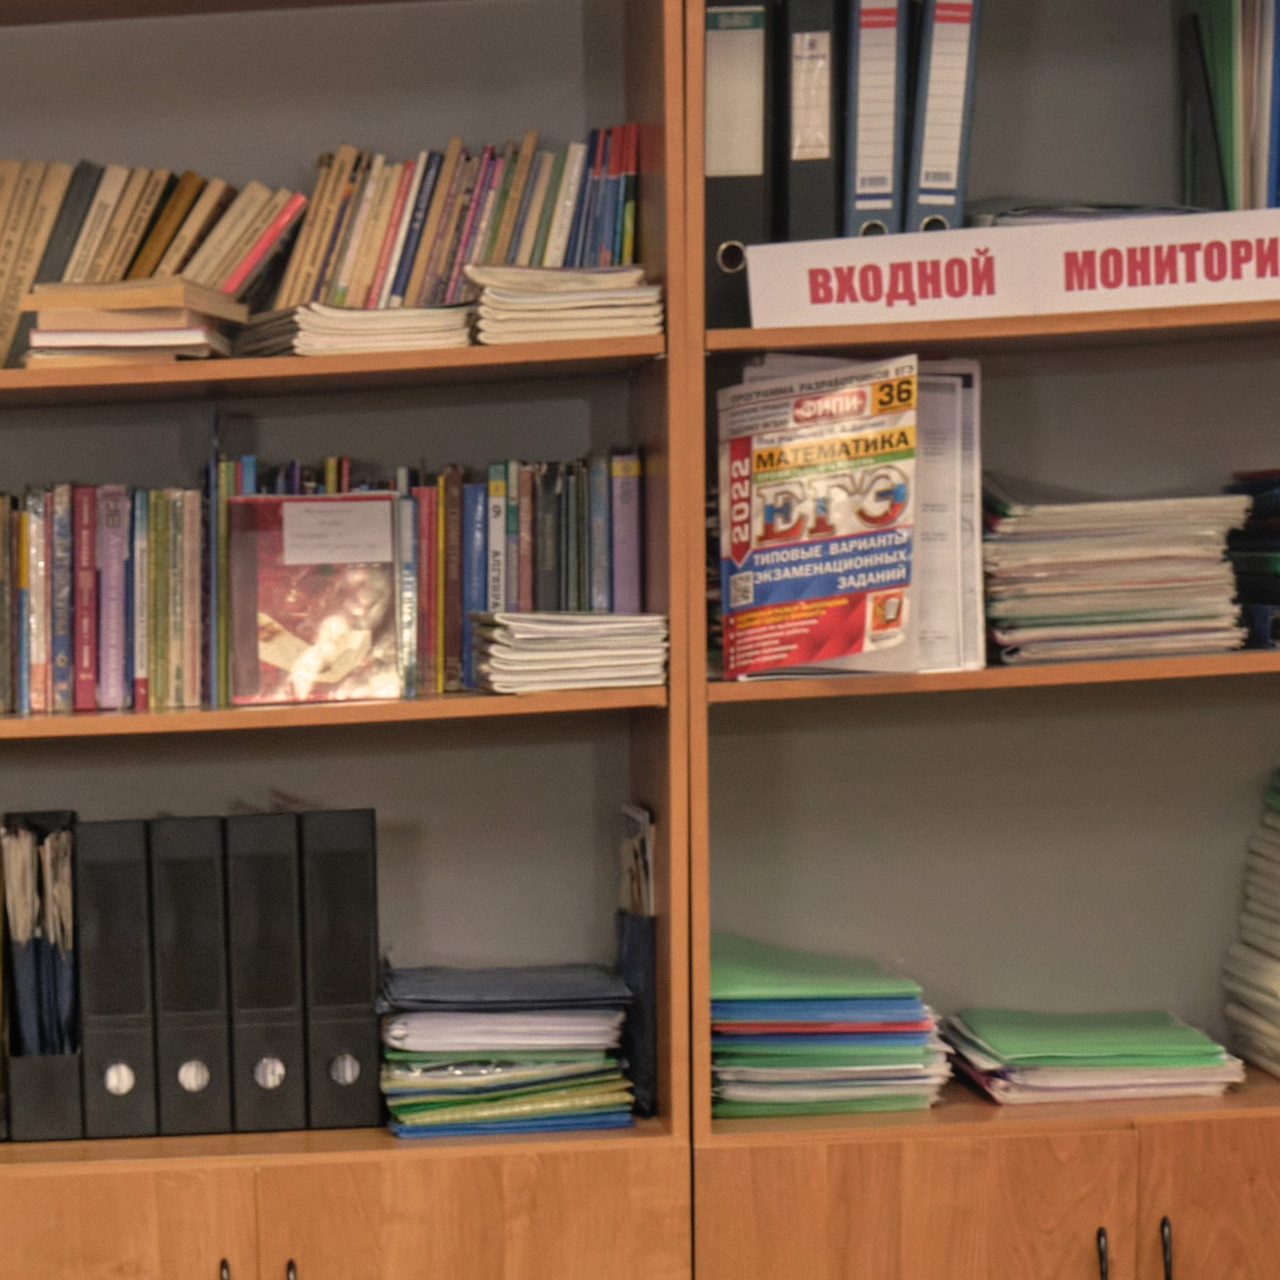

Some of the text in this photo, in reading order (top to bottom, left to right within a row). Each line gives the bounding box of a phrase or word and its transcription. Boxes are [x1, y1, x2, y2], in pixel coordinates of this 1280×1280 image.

[807, 236, 1280, 307] ВХОДНОЙ МОНИТОРИ
[878, 380, 912, 407] 36
[755, 430, 910, 470] МАТЕМАТИКА
[731, 457, 750, 544] 2022
[755, 464, 910, 543] ЕГЭ
[753, 530, 909, 567] ТИПОВЫЕ ВАРИАНТЫ
[753, 550, 908, 585] ЭКЗАМЕНАЦИОННЫХ
[837, 564, 907, 590] ЗАДАНИЙ
